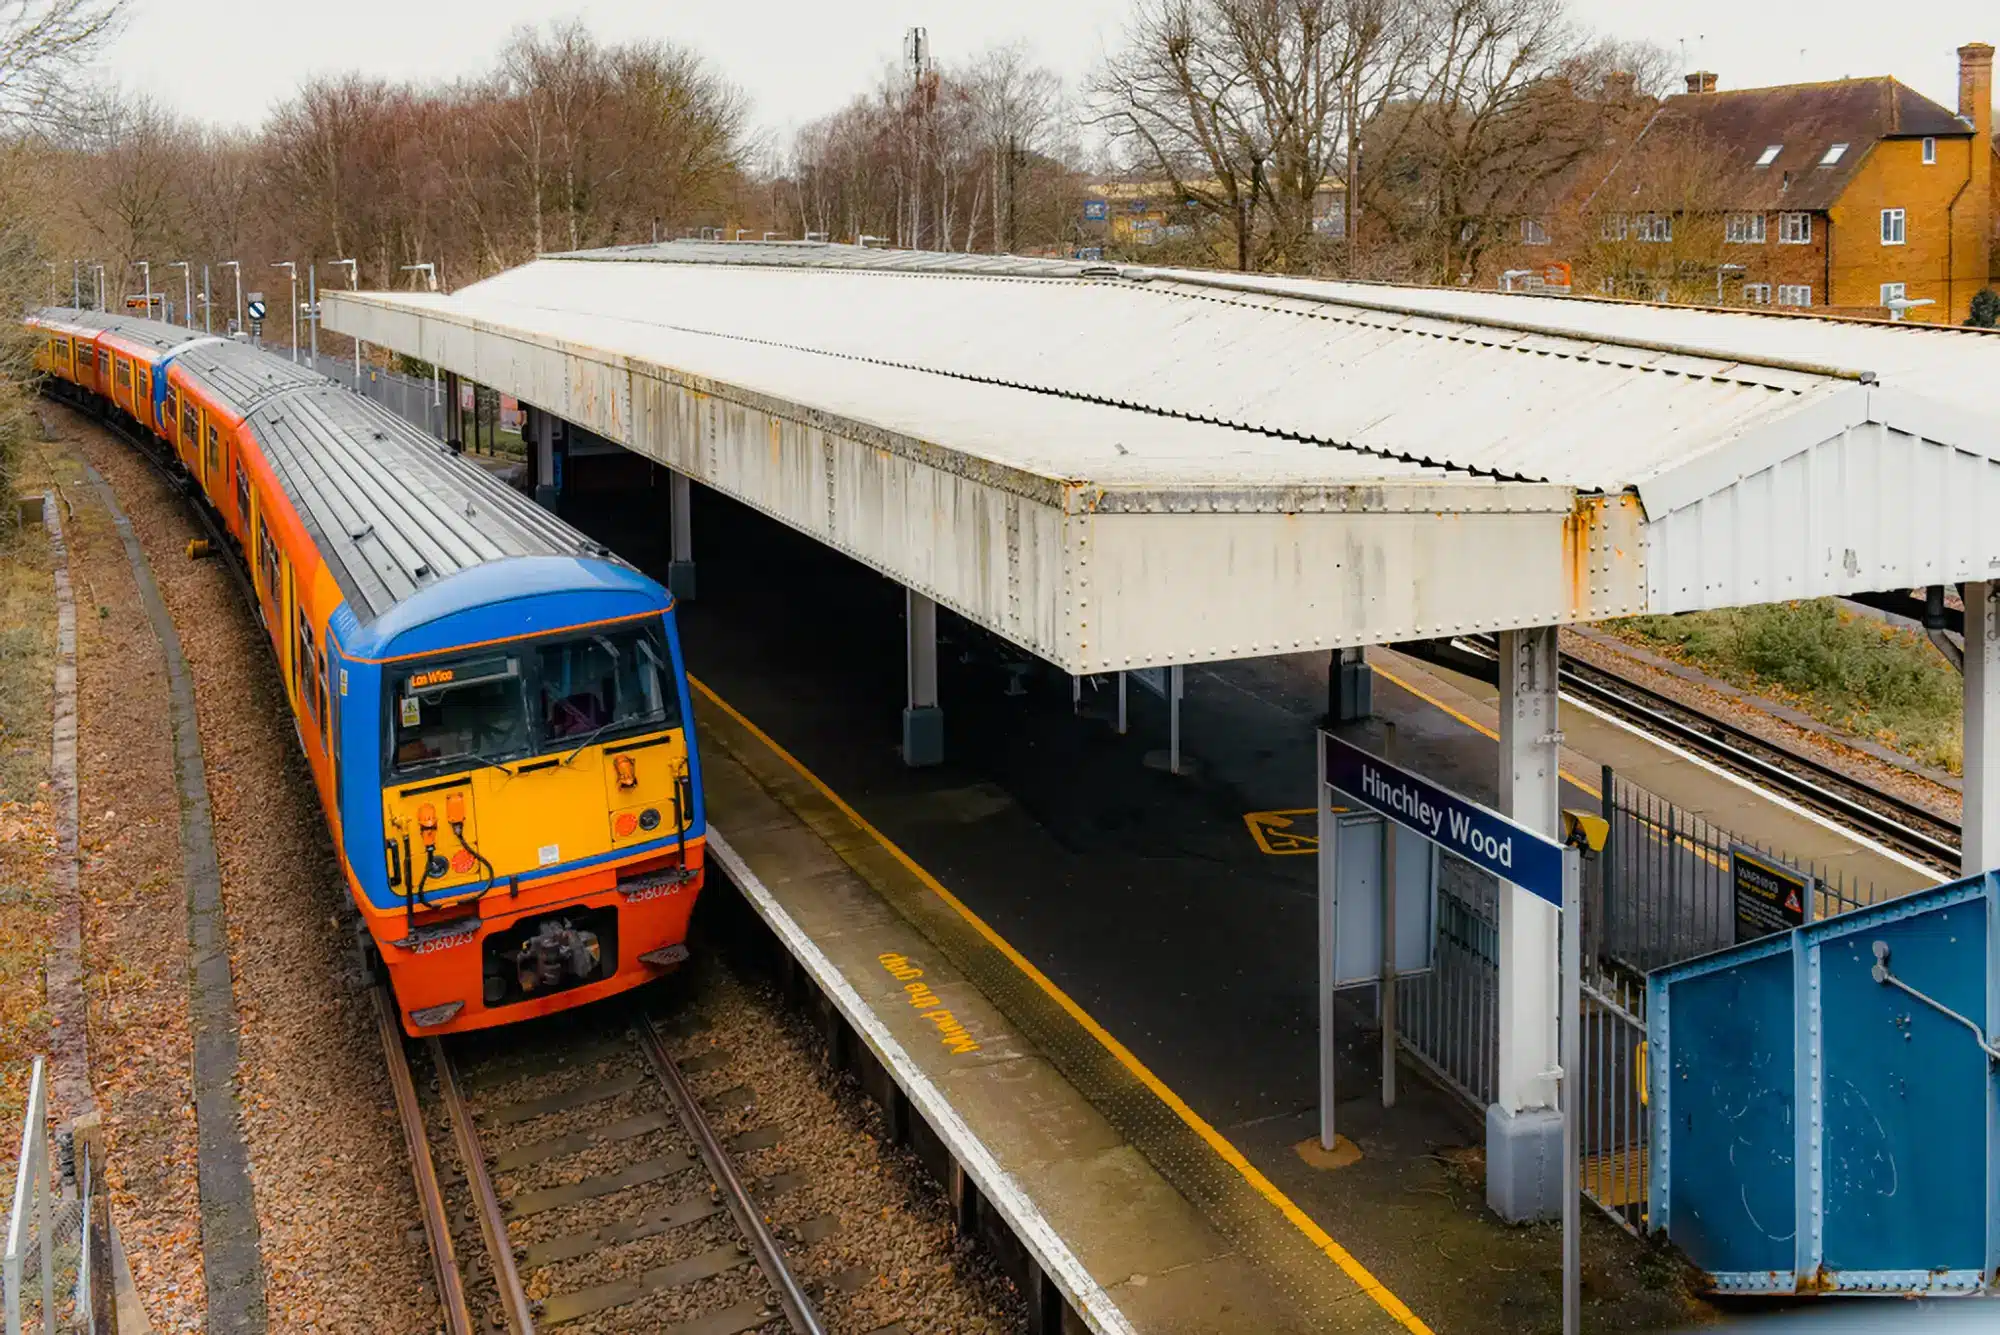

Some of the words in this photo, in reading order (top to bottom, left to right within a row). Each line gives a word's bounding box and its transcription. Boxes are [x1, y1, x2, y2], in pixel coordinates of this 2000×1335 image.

[1362, 764, 1443, 836] Hinchley
[1449, 807, 1512, 868] Wood
[878, 952, 924, 981] gap
[904, 982, 941, 1009] the
[920, 1009, 980, 1055] Mind
